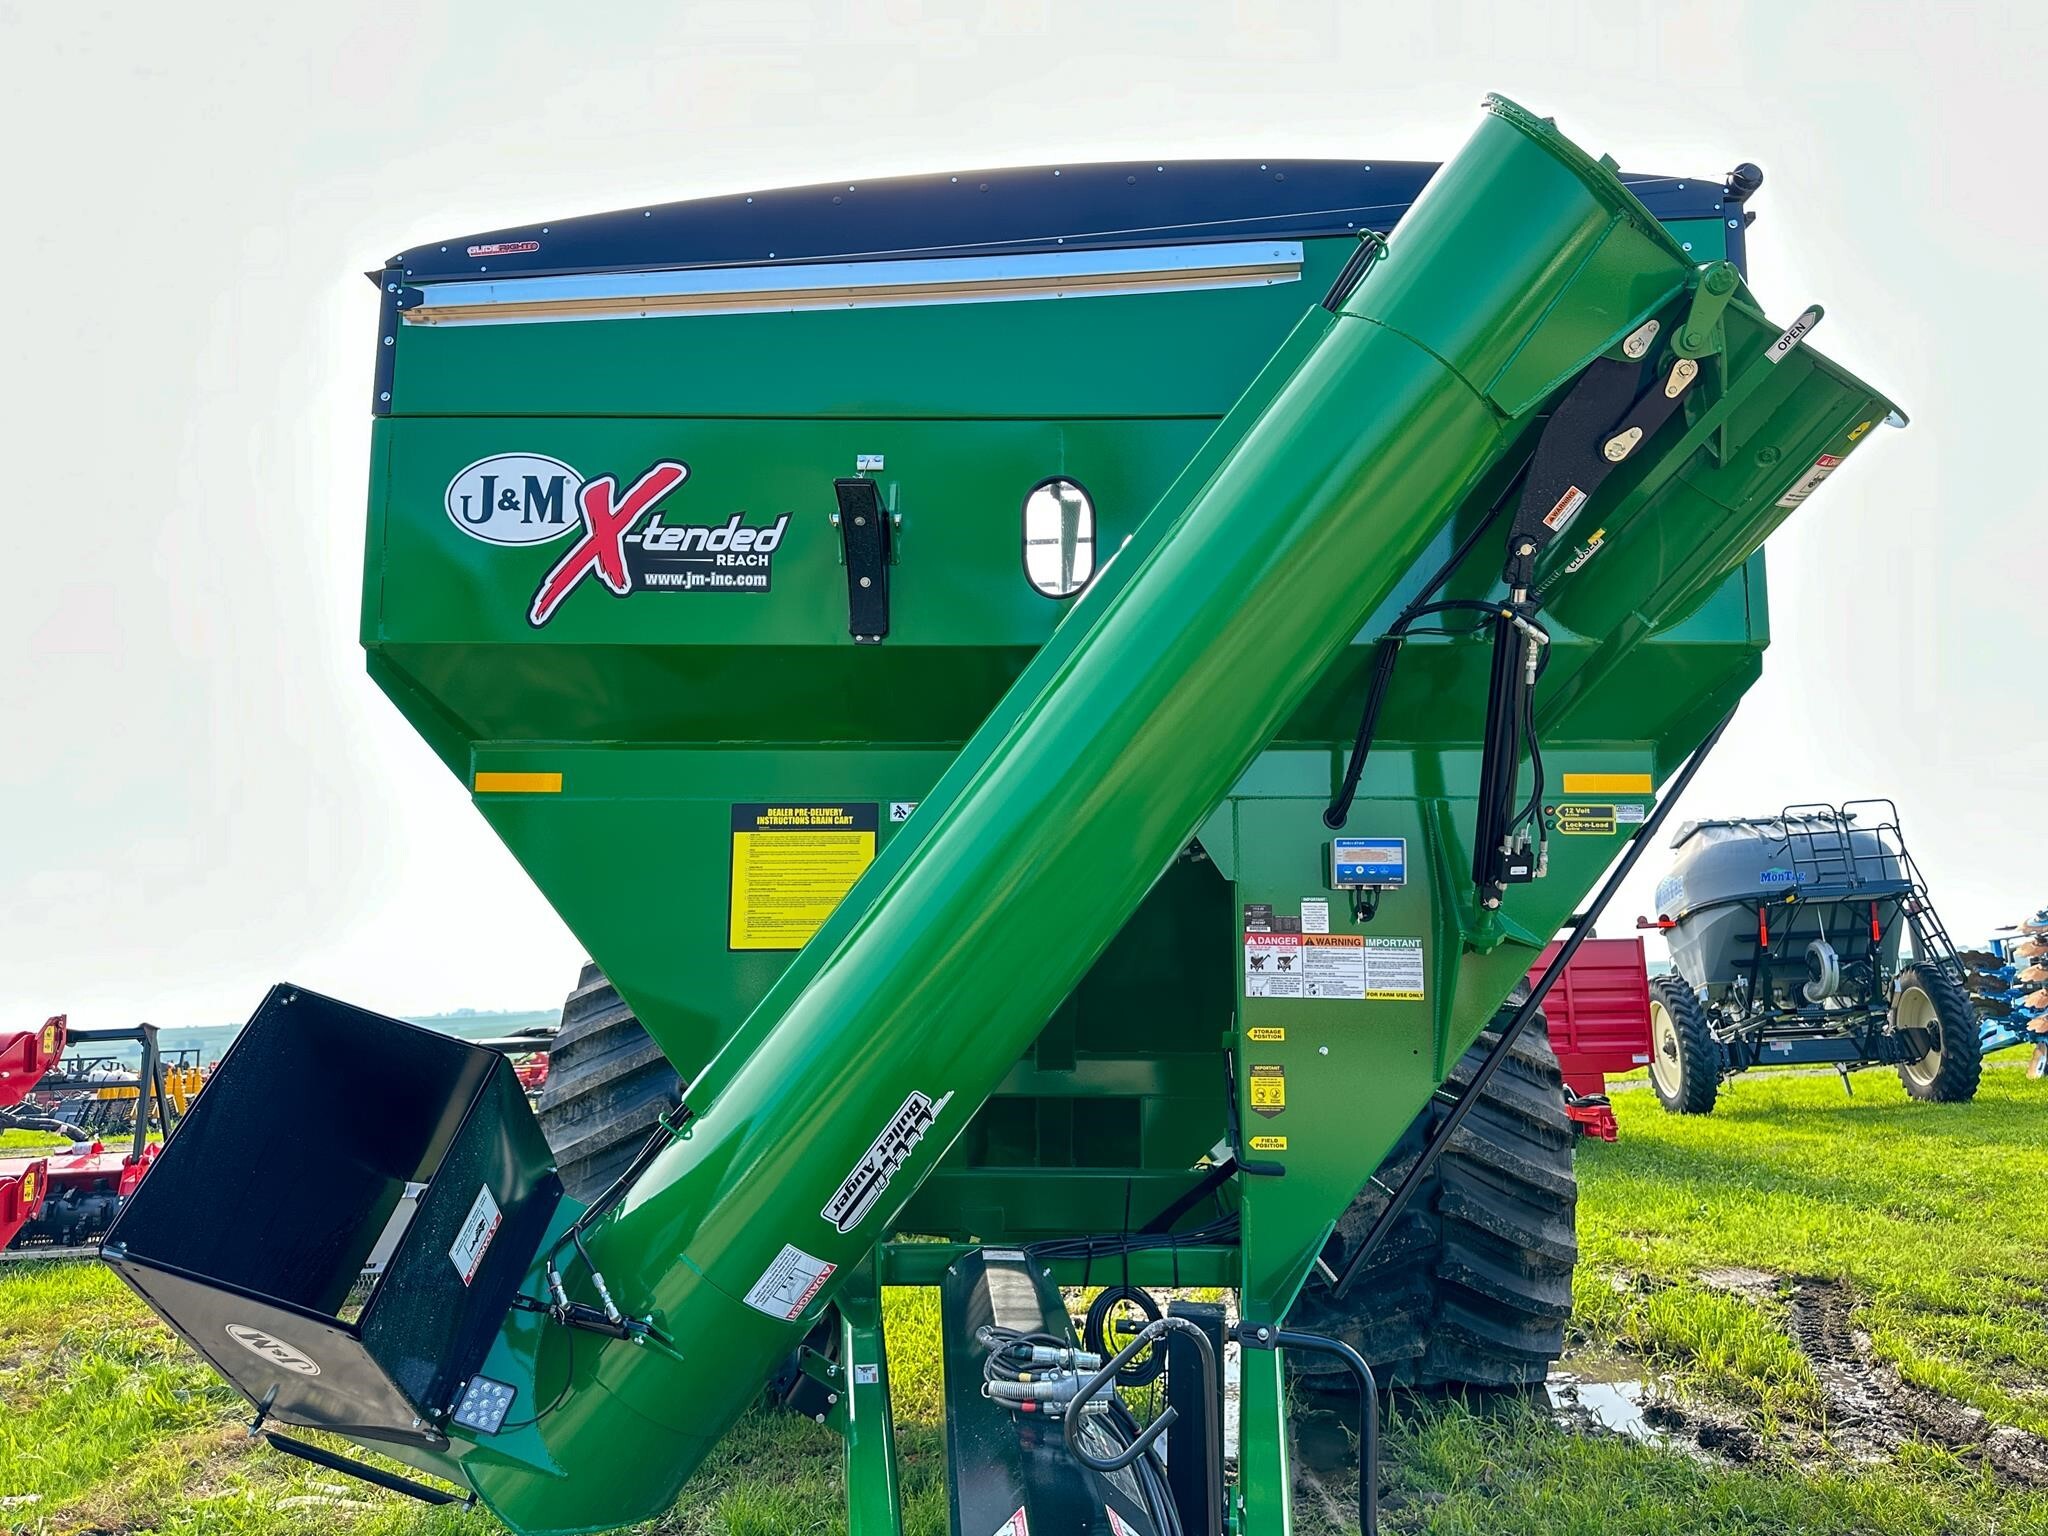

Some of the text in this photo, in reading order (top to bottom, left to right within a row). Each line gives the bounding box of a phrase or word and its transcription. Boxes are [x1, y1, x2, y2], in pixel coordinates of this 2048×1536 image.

[1777, 322, 1806, 352] OPEN
[460, 475, 567, 524] J&M
[1553, 490, 1576, 517] WARNING
[716, 554, 769, 567] REACH
[645, 573, 767, 588] www.jm-inc.com
[767, 808, 843, 817] DEALER PRE-DELIVERY
[757, 816, 853, 825] INSTRUCTIONS GRAIN CART
[1257, 936, 1298, 945] DANGER
[1316, 938, 1361, 946] WARNING
[1365, 938, 1422, 948] IMPORTANT
[833, 1098, 922, 1216] Bullet Auger
[787, 1275, 827, 1319] DANGER
[234, 1331, 313, 1370] J&M
